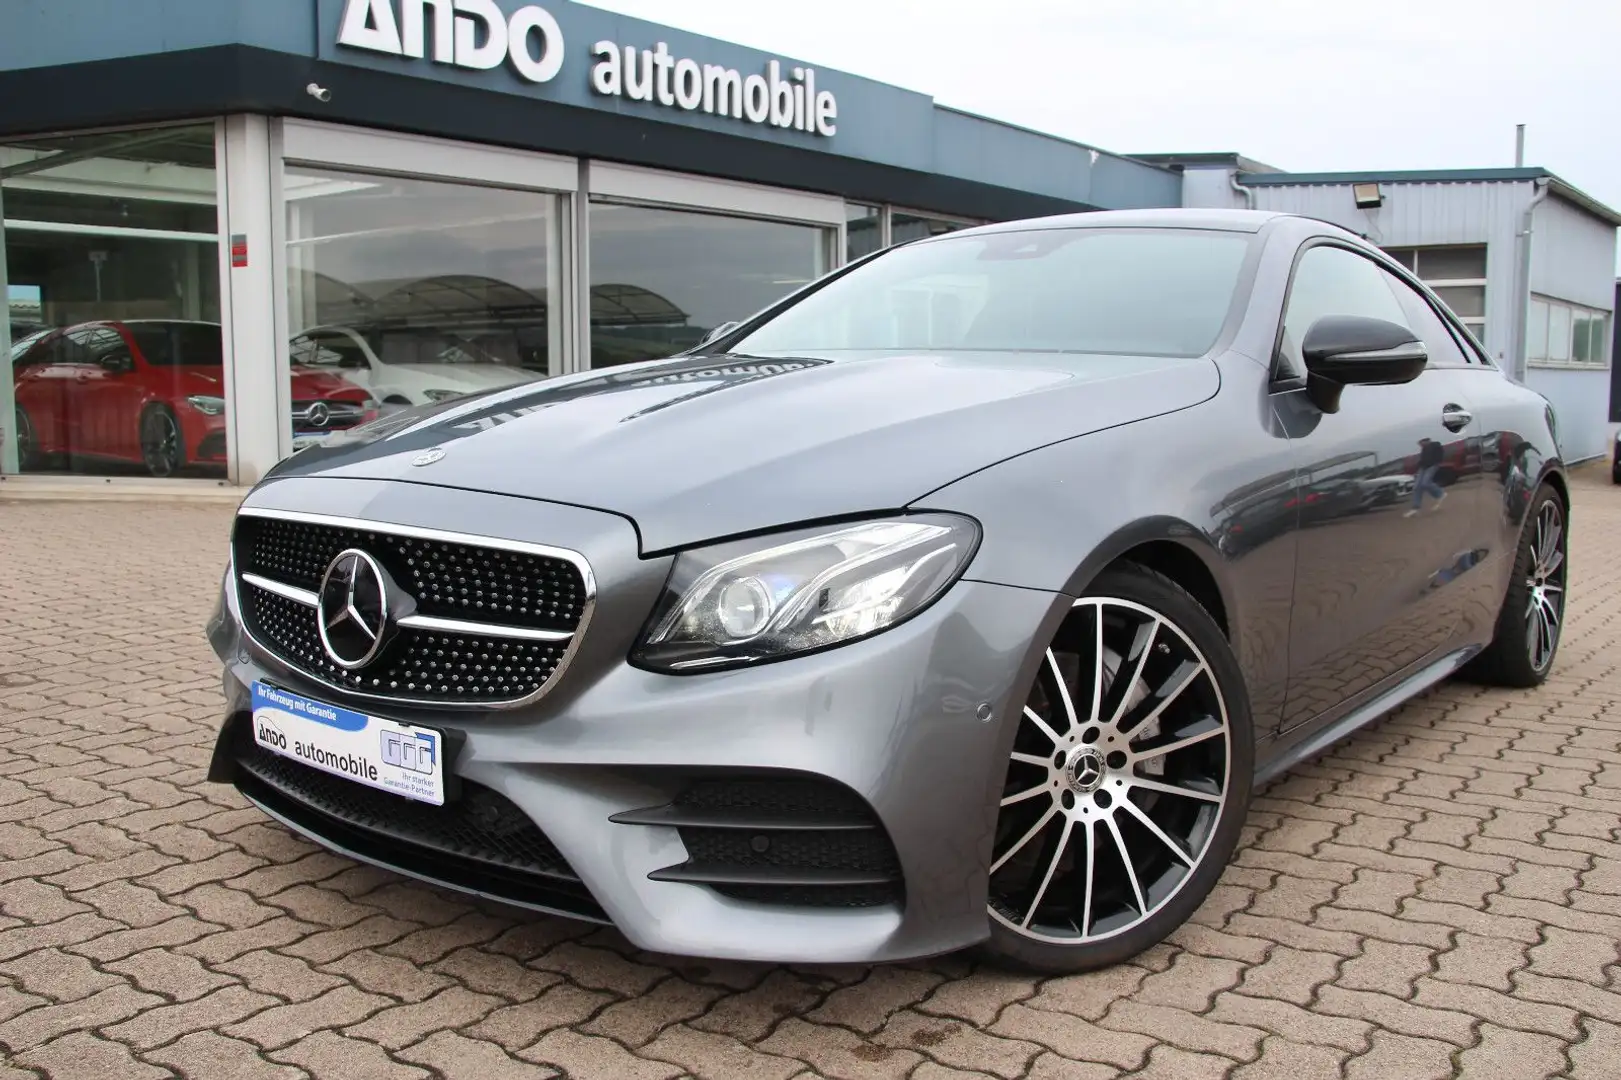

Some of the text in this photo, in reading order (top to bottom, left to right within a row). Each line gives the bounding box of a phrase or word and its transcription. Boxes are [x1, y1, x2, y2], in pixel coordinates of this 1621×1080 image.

[591, 40, 837, 136] automobile
[258, 685, 337, 720] Ihr Fahrzeug mit Garantie
[295, 741, 378, 781] automobile
